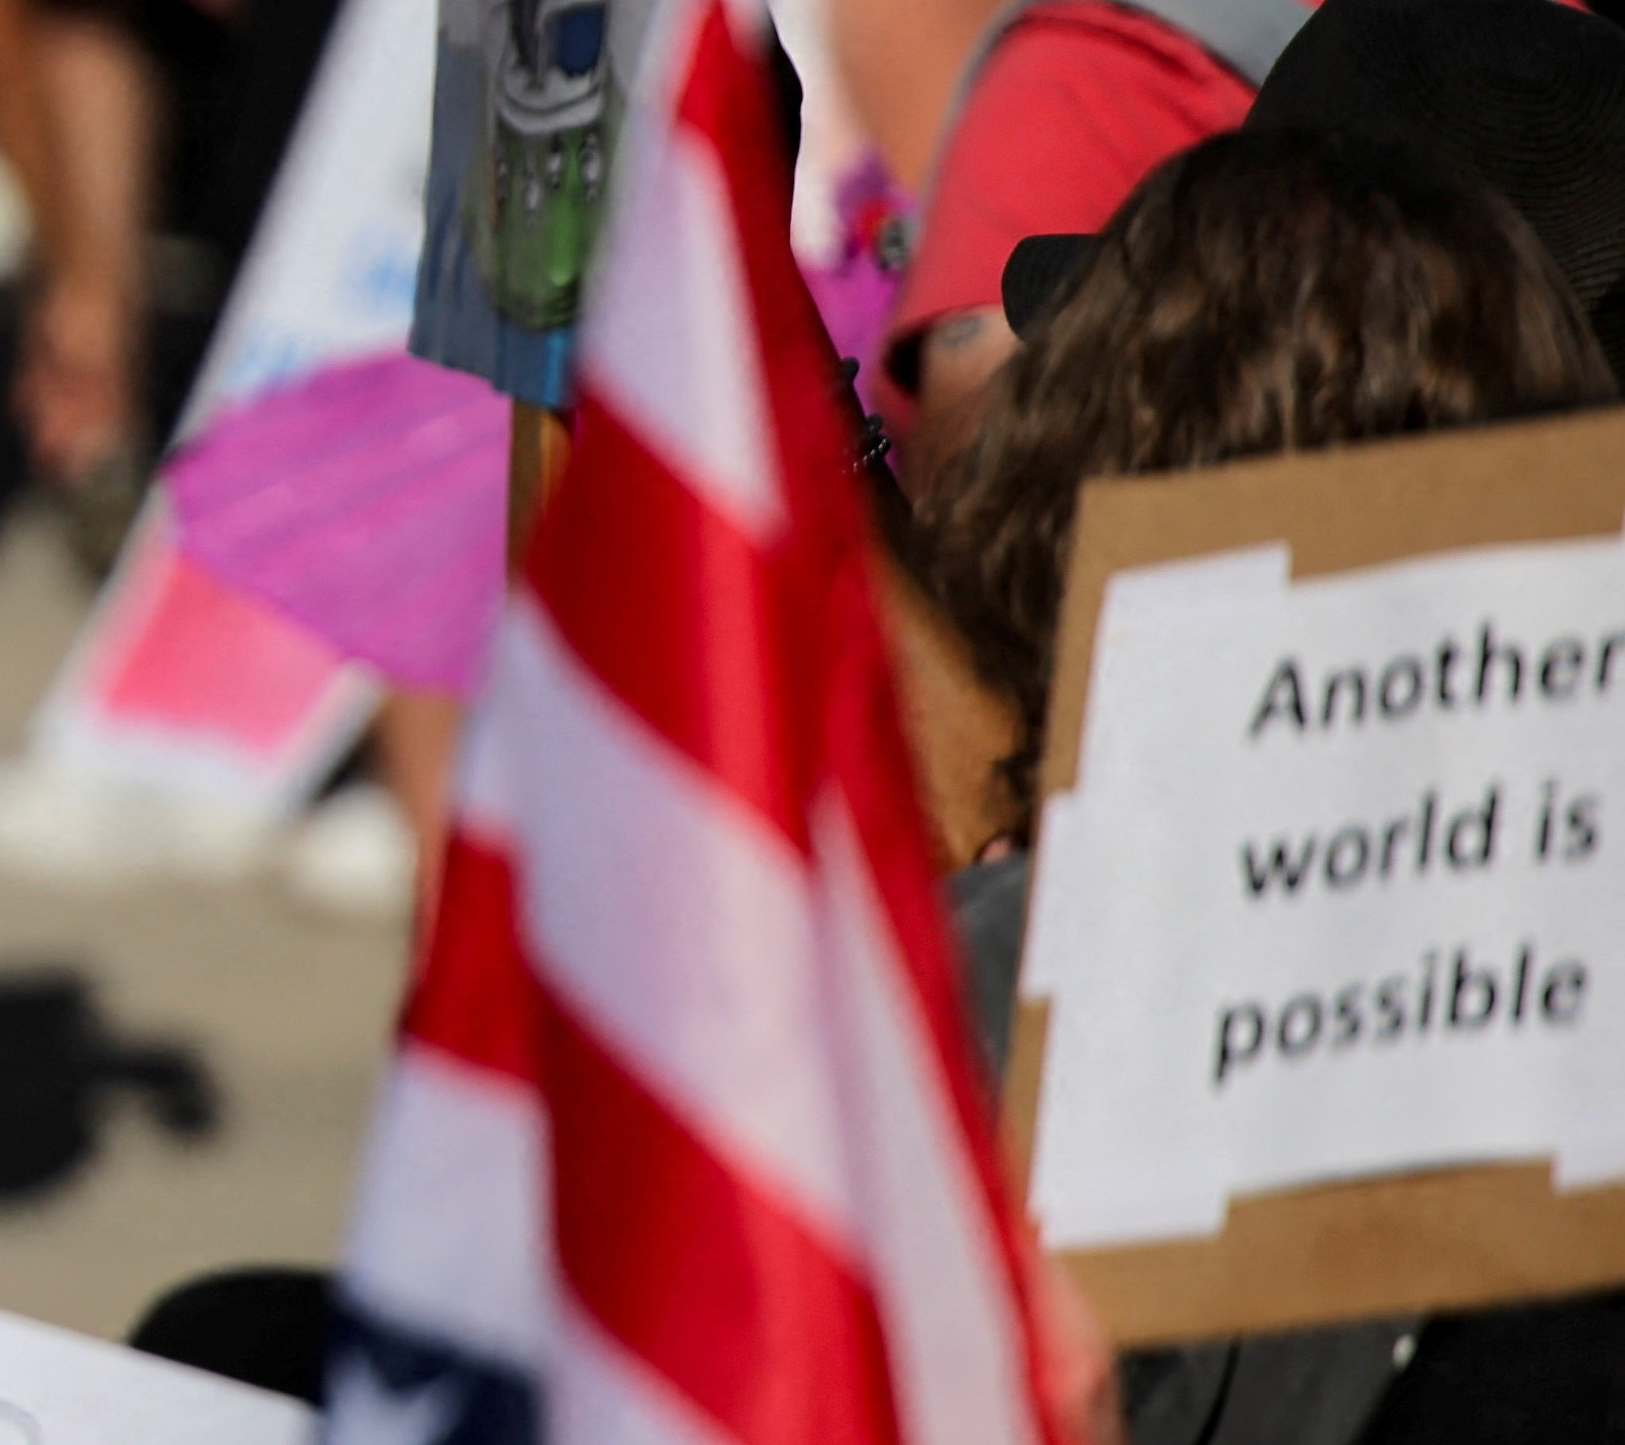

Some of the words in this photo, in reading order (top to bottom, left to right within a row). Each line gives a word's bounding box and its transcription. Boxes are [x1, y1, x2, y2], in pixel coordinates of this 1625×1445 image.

[1245, 615, 1625, 741] Another
[1239, 783, 1502, 898] world
[1533, 775, 1601, 863] is
[1212, 943, 1589, 1089] possible
